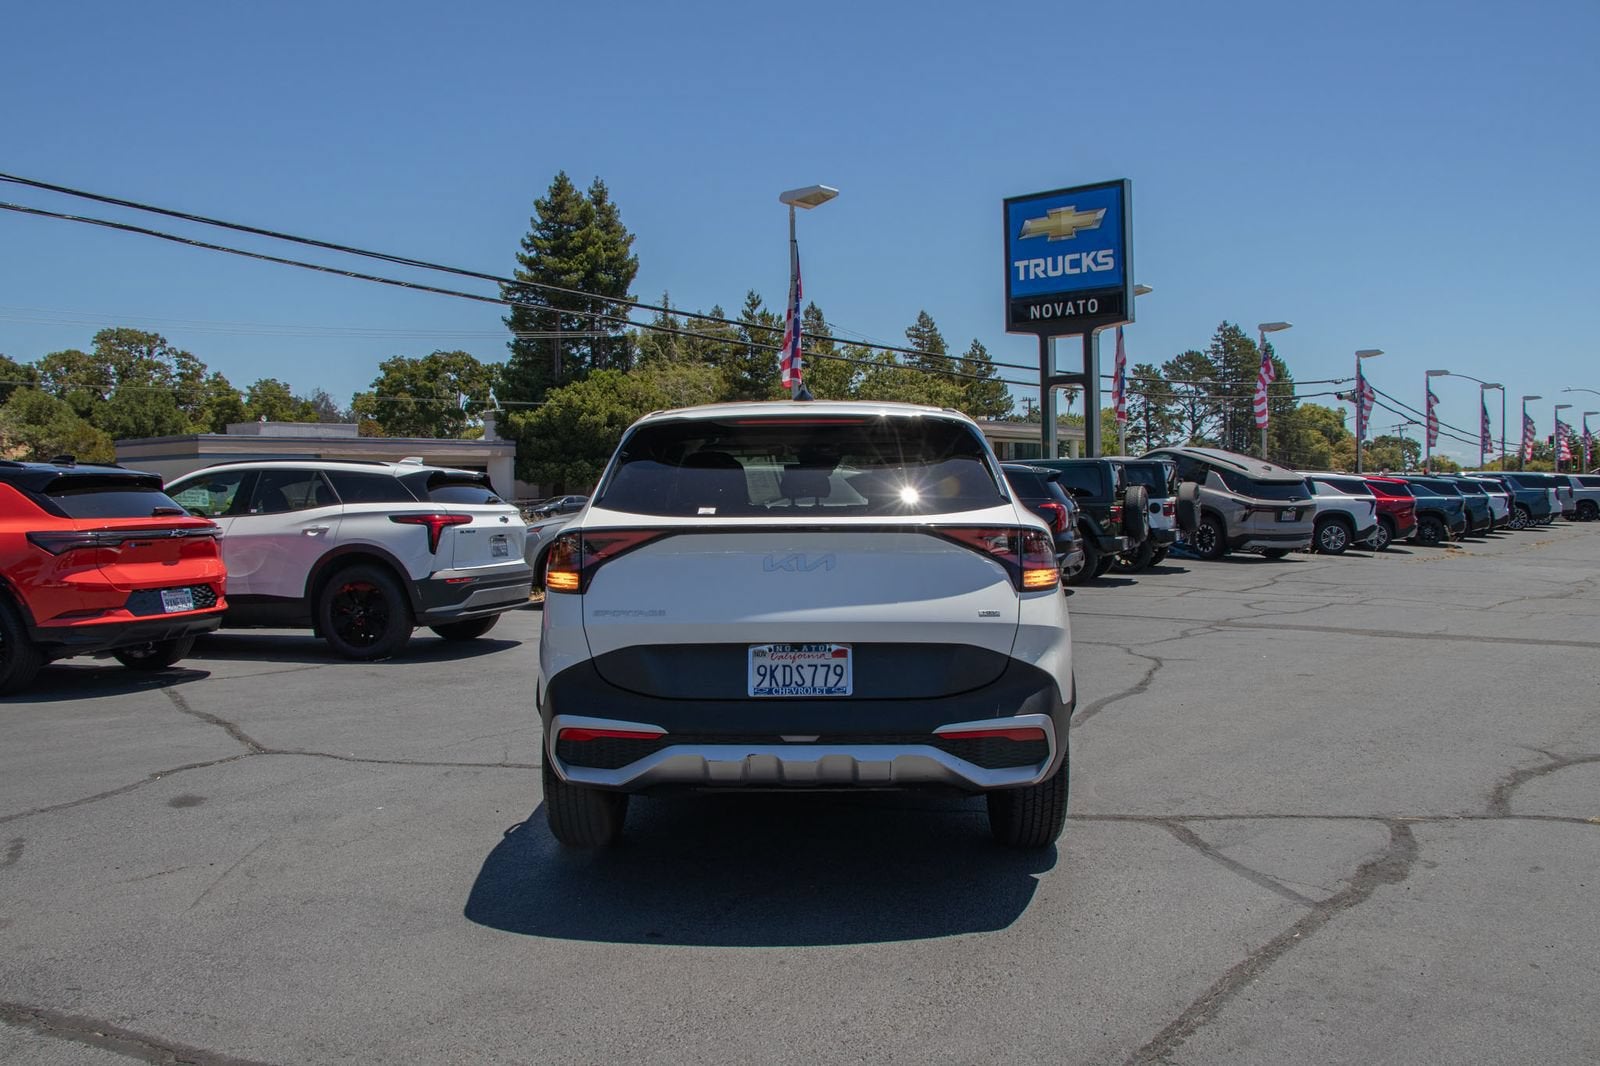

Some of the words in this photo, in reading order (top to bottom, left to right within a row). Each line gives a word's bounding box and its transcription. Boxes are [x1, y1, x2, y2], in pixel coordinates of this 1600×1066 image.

[1014, 249, 1115, 281] TRUCKS
[1030, 299, 1099, 320] NOVATO
[763, 553, 836, 572] KIA
[775, 643, 826, 652] NOATO
[769, 651, 832, 664] California
[756, 664, 845, 688] 9KDS779
[771, 687, 827, 695] CHEVROLET
